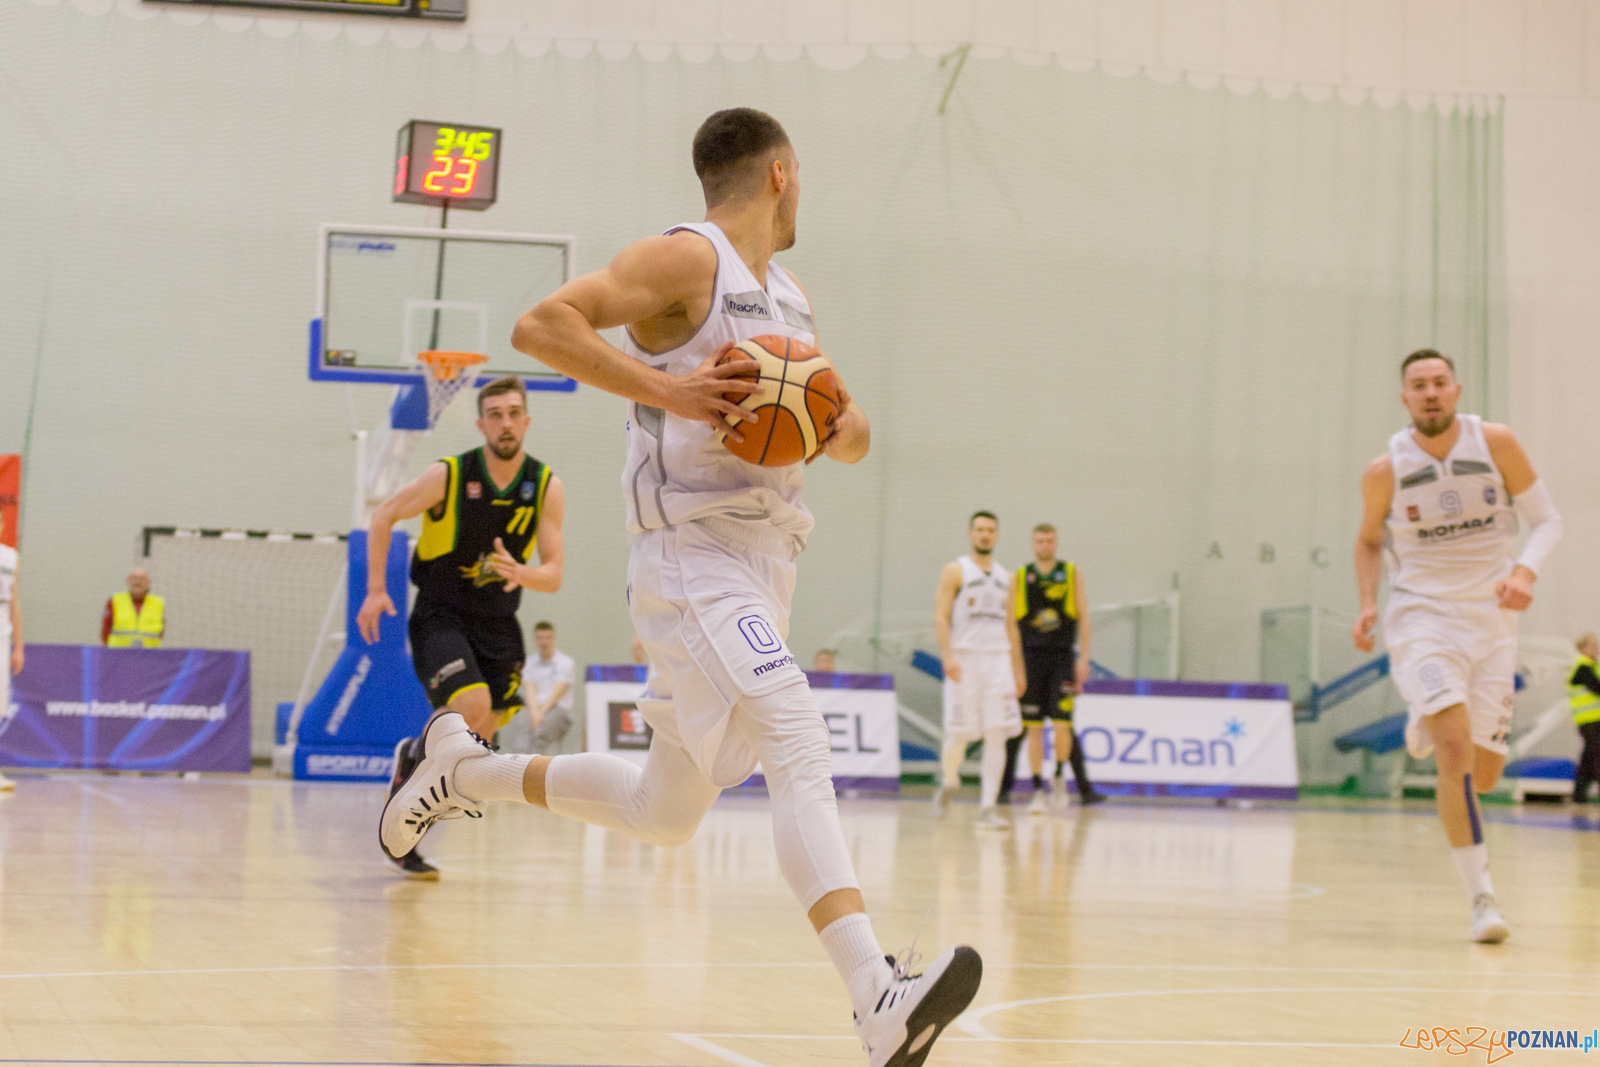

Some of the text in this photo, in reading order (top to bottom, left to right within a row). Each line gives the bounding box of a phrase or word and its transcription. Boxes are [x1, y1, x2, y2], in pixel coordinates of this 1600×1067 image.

[421, 155, 480, 197] 23
[729, 300, 768, 316] macron
[506, 506, 535, 536] 11
[738, 614, 782, 655] 0
